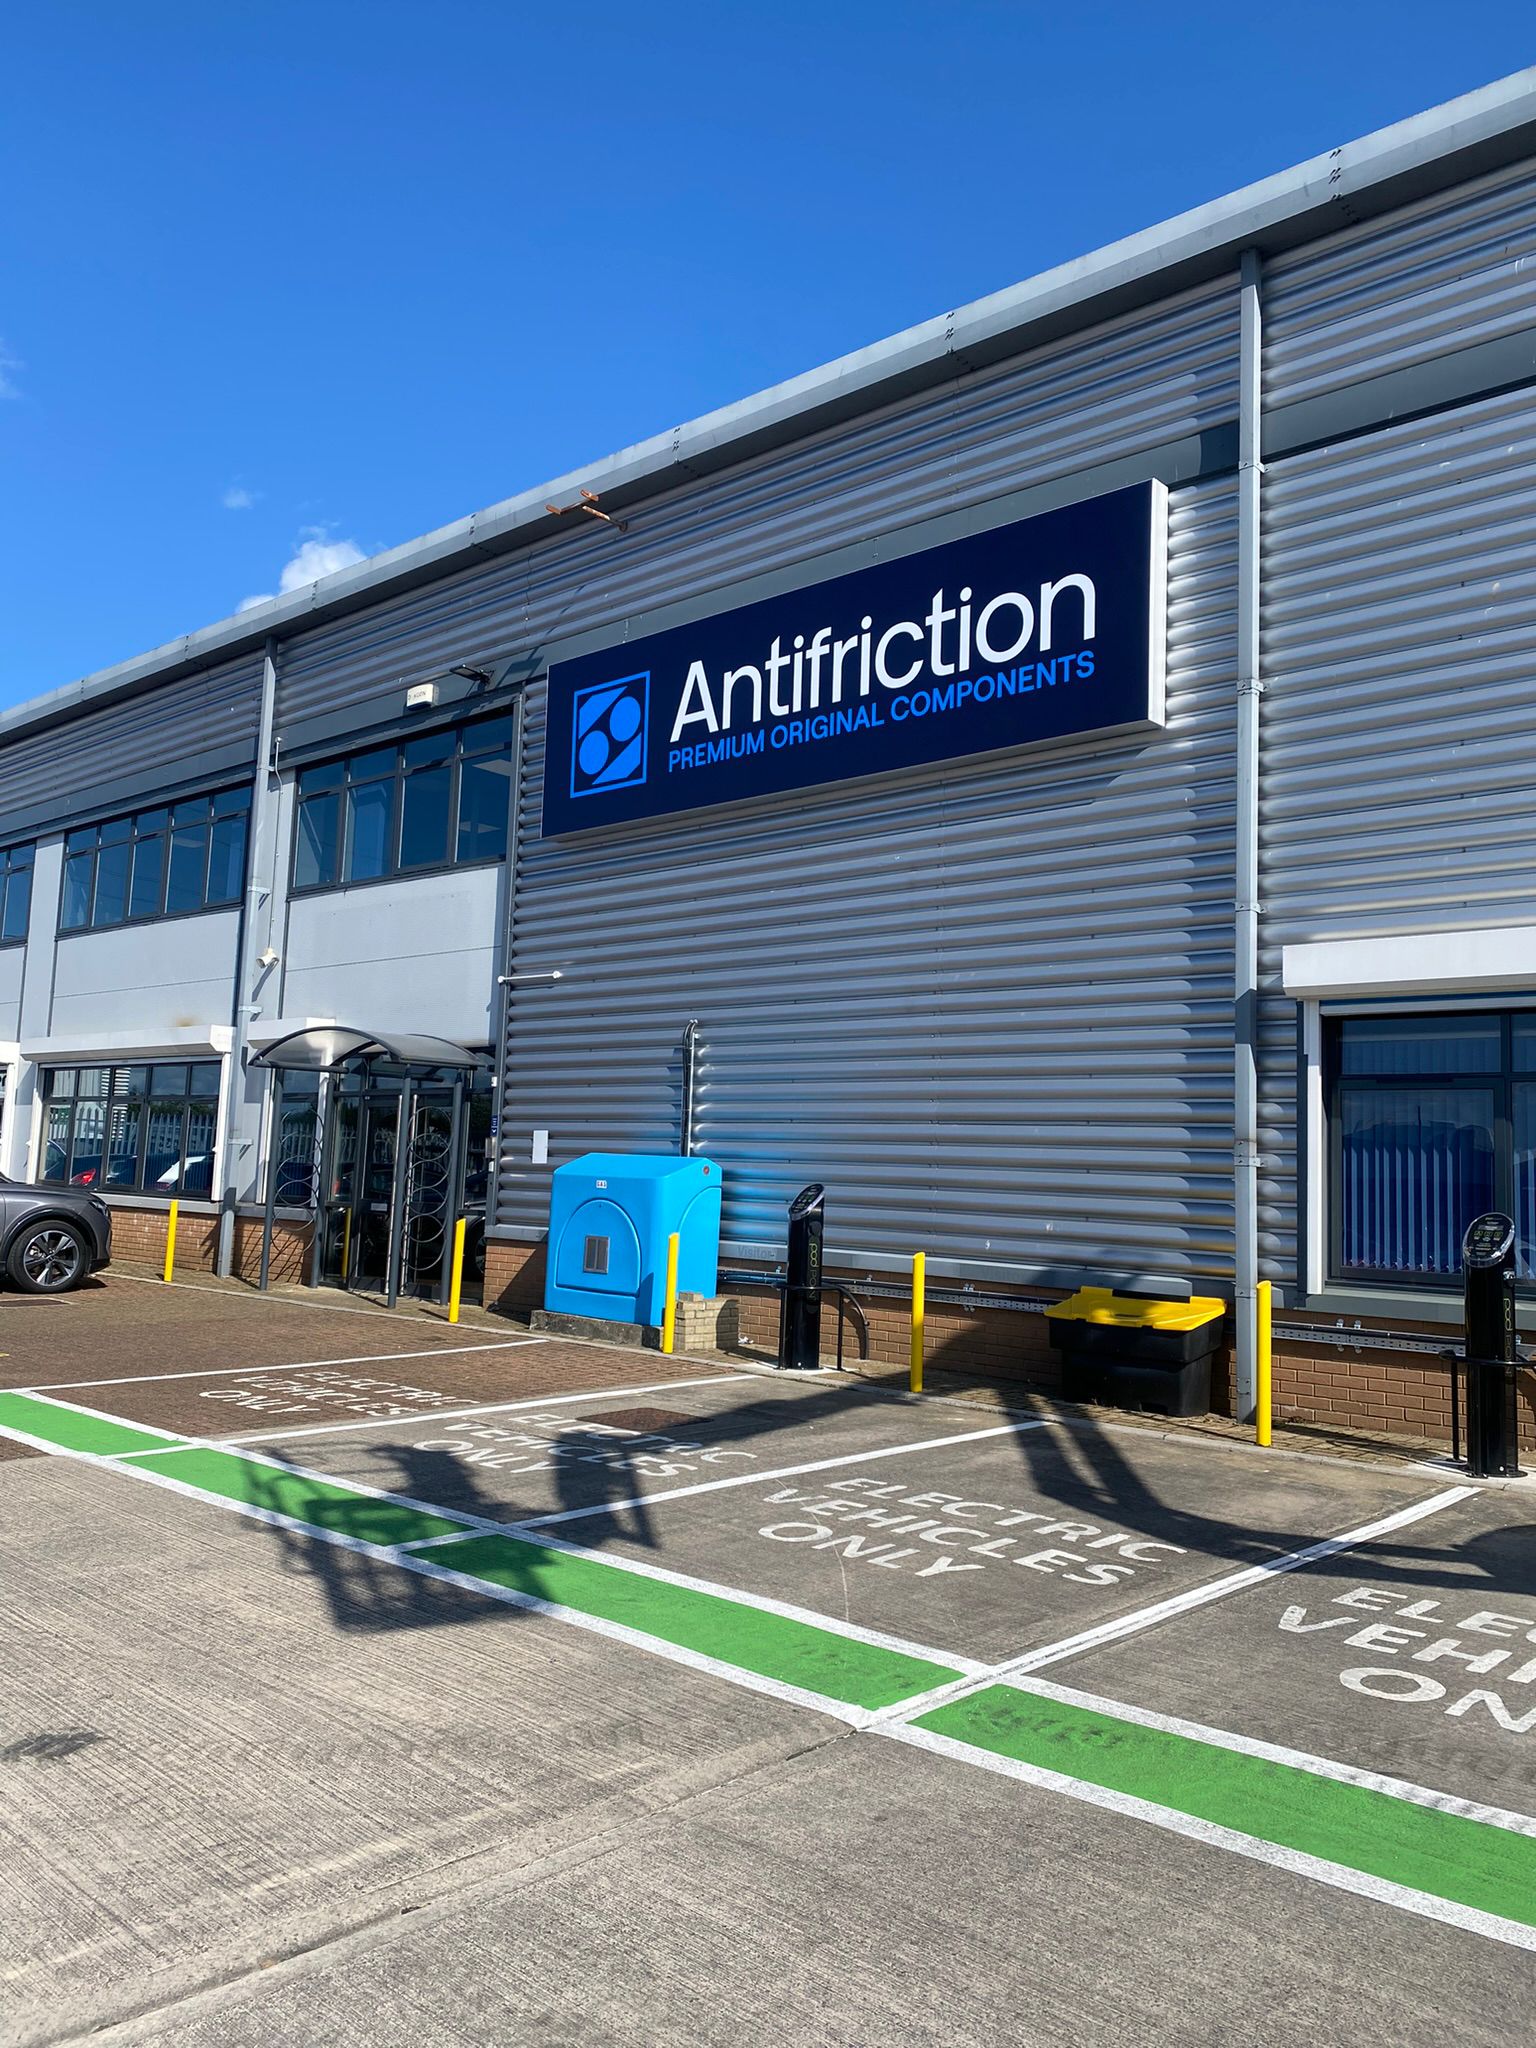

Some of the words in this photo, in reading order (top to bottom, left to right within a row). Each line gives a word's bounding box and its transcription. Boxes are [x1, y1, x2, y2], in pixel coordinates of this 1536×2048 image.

[670, 573, 1096, 742] Antifriction
[668, 729, 765, 773] PREMIUM
[770, 701, 885, 751] ORIGINAL
[891, 650, 1096, 722] COMPONENTS
[199, 1389, 321, 1413] ONLY
[413, 1440, 570, 1473] ONLY
[444, 1423, 698, 1477] VEHICLES
[508, 1413, 758, 1463] ELECTRIC
[763, 1488, 1135, 1585] VEHICLES
[823, 1478, 1187, 1562] ELECTRIC
[758, 1522, 986, 1577] ONLY
[1331, 1587, 1536, 1644] ELE
